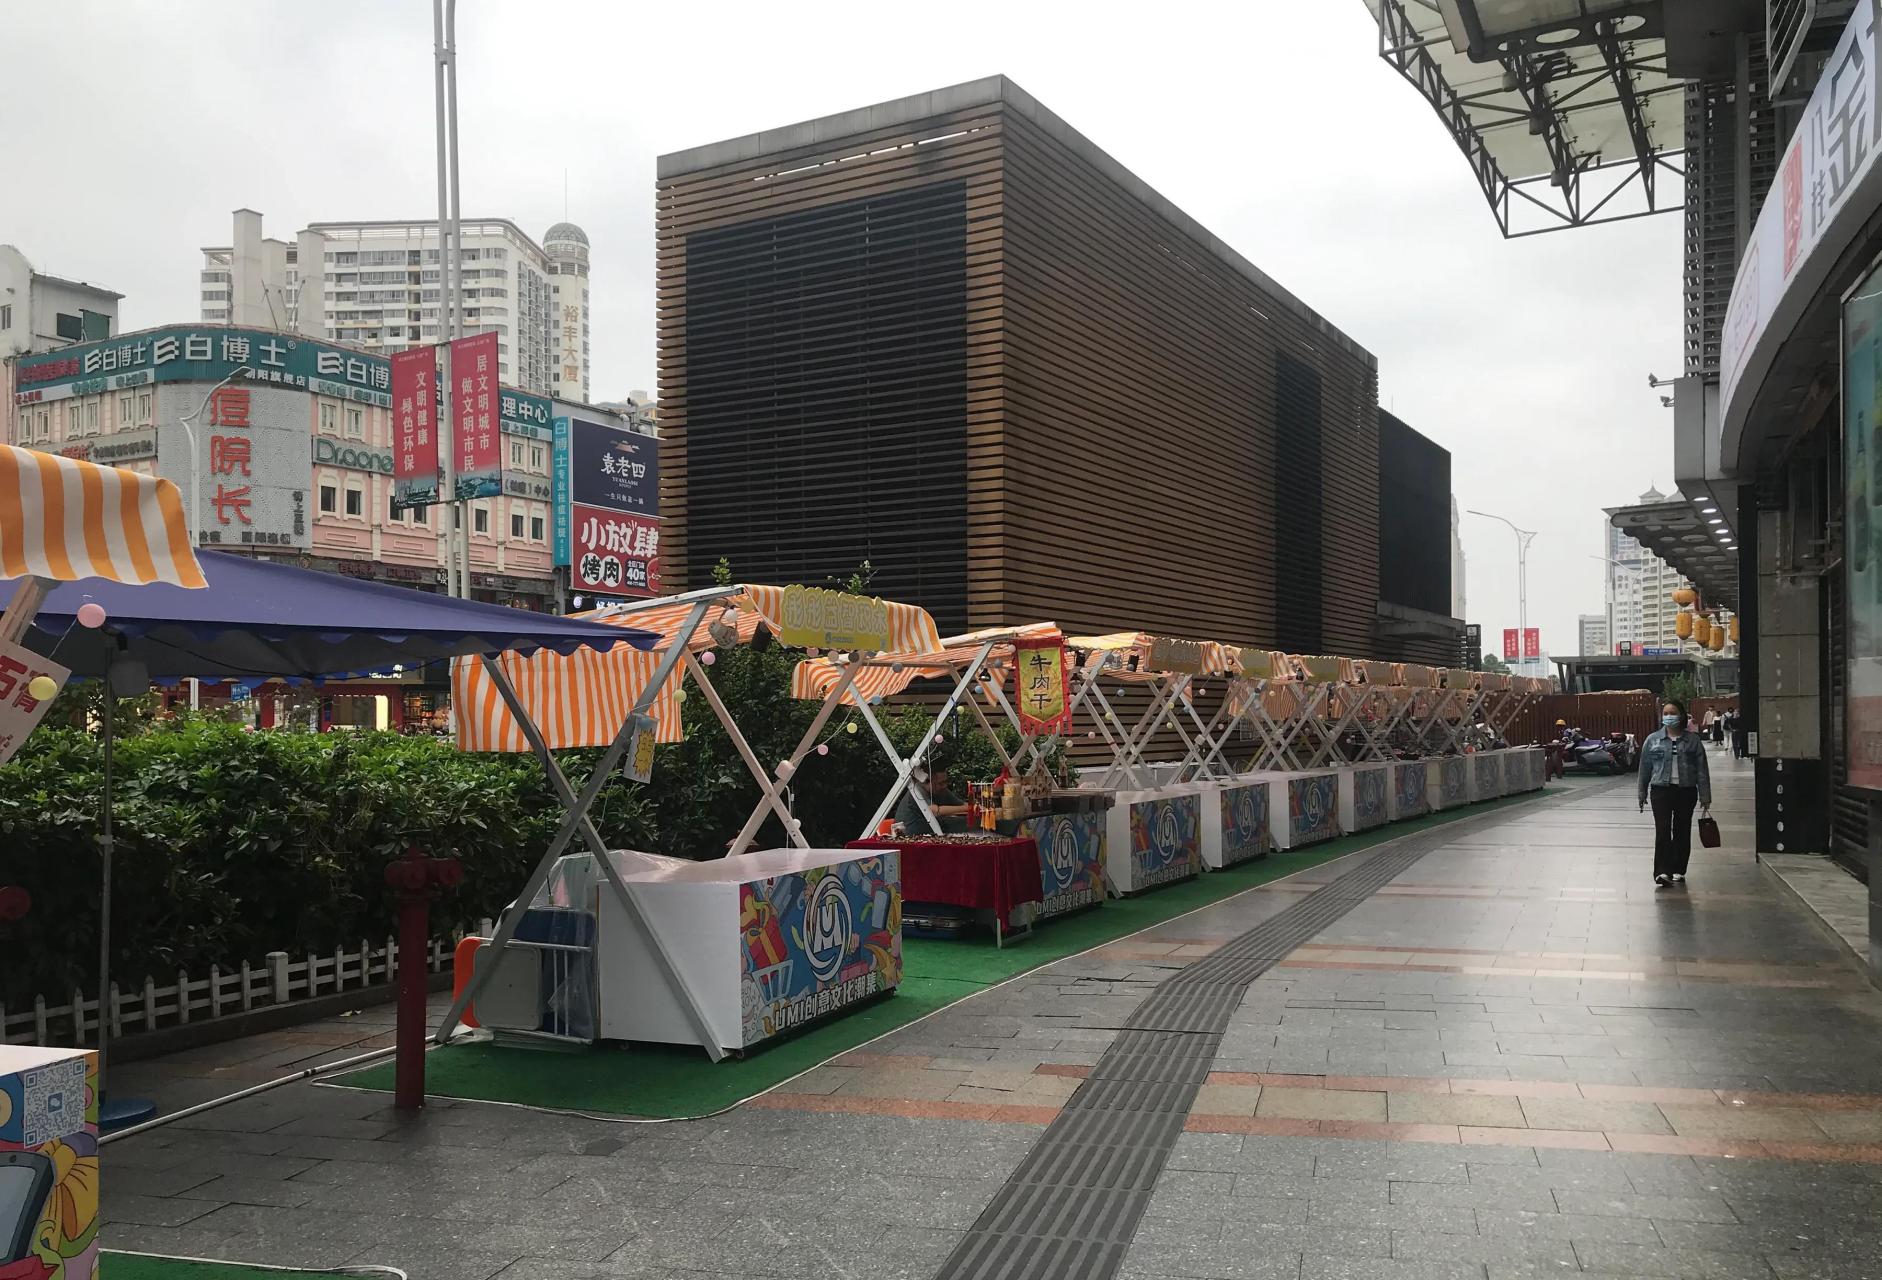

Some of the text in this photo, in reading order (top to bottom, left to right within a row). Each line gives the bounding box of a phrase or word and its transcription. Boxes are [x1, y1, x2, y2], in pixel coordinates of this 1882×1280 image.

[103, 341, 147, 371] 白博士
[185, 333, 287, 367] 白博士
[562, 304, 579, 383] 裕丰大厦
[415, 371, 428, 446] 文明健康
[461, 377, 475, 473] 做文明市民
[476, 354, 490, 451] 居文明城市
[502, 396, 549, 424] 理中心
[402, 397, 415, 472] 绿色环保
[555, 421, 568, 468] 白博士
[601, 452, 646, 478] 袁老四
[581, 517, 659, 558] 小放肆
[582, 555, 620, 584] 烤肉
[1029, 654, 1053, 710] 牛肉干
[775, 971, 878, 1030] UMI创意文化潮集
